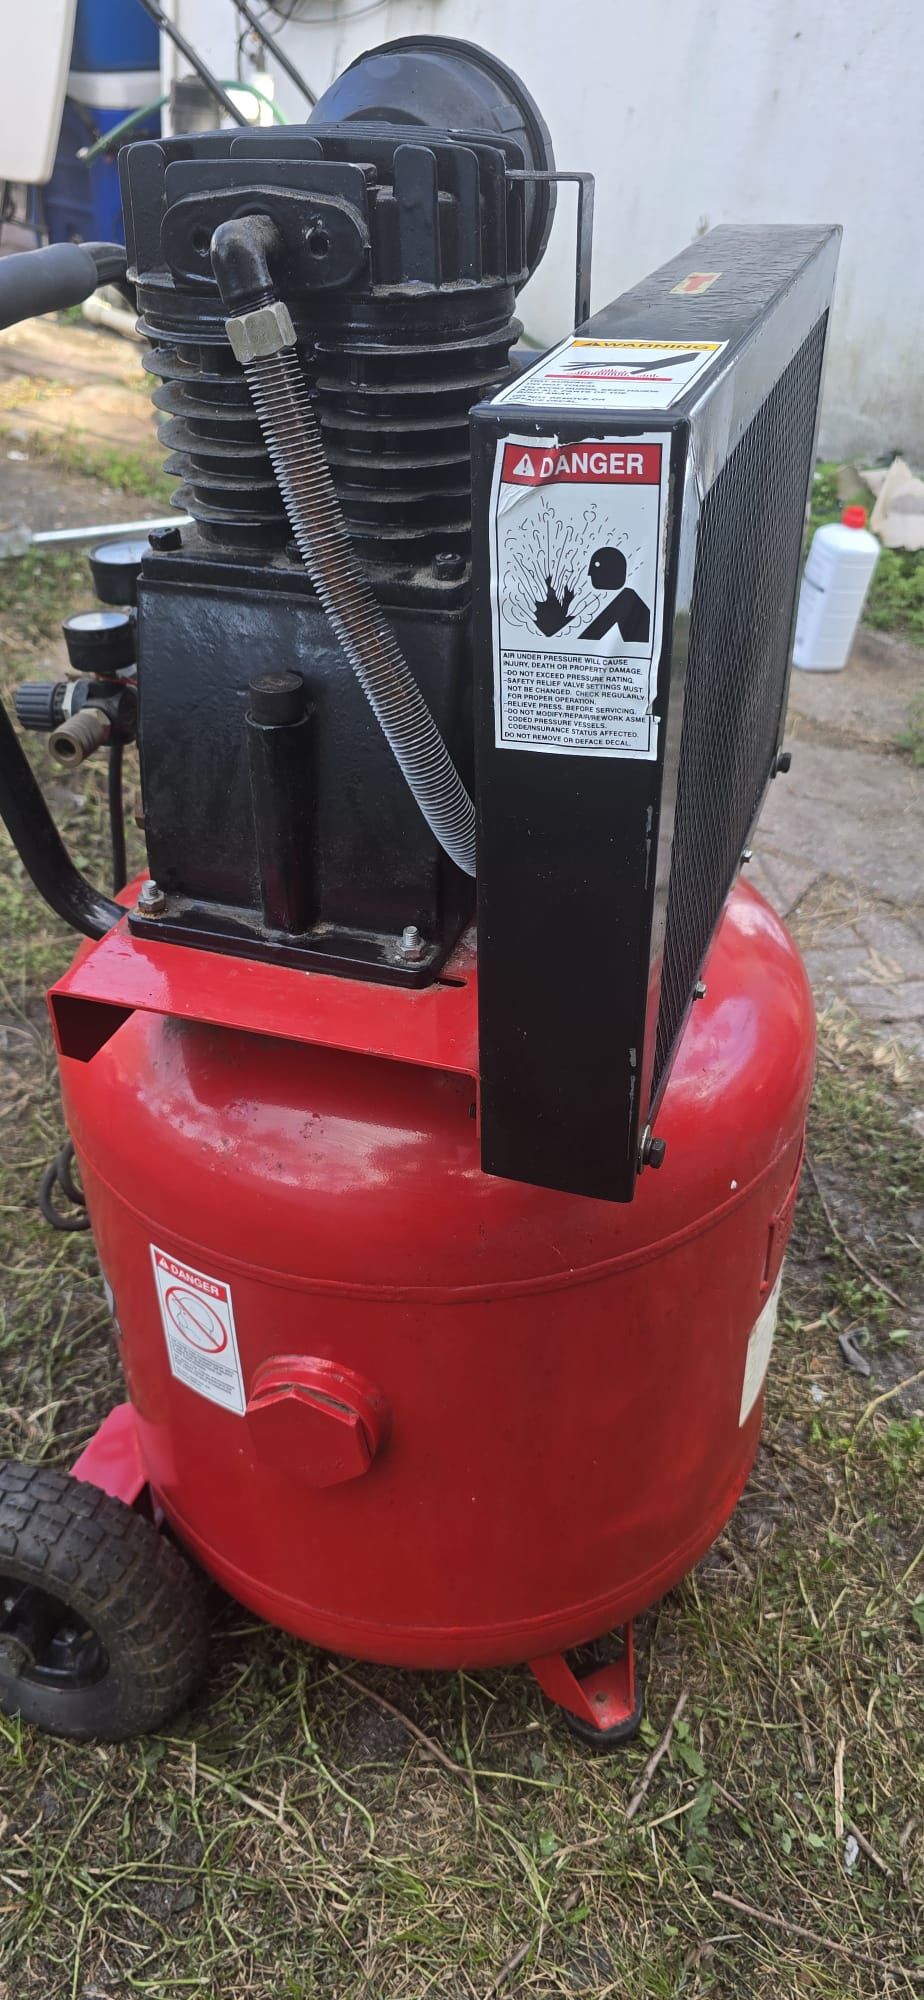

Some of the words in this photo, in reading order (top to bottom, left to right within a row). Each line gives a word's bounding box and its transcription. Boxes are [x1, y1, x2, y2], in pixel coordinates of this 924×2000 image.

[603, 341, 710, 350] WARNING
[539, 453, 644, 478] DANGER
[570, 665, 607, 673] PROPERTY
[609, 667, 643, 675] DAMAGE.
[567, 674, 604, 682] PRESSURE
[623, 685, 643, 693] MUST
[555, 696, 596, 705] OPERATION.
[602, 692, 645, 700] REGULARLY
[596, 707, 636, 715] SERVICING.
[536, 710, 624, 722] MODIFY/REPAIR/REWORK
[534, 718, 572, 726] PRESSURE
[508, 723, 569, 734] CODE/INSURANCE
[169, 1264, 220, 1297] DANGER
